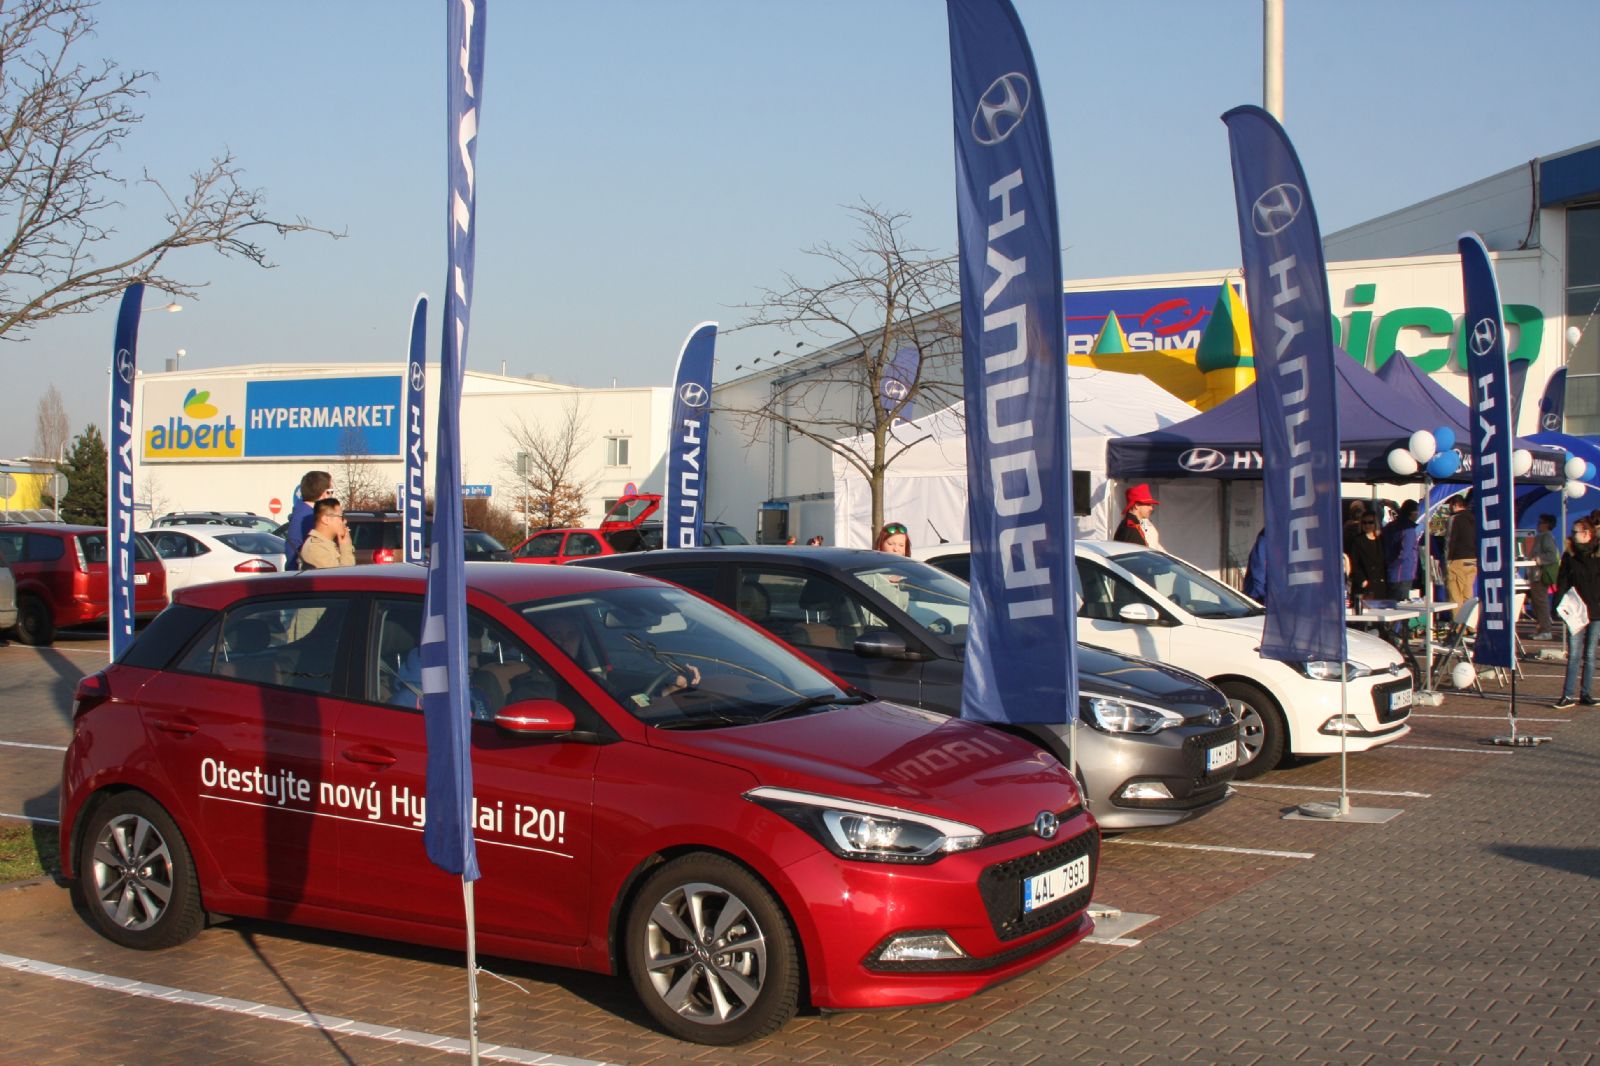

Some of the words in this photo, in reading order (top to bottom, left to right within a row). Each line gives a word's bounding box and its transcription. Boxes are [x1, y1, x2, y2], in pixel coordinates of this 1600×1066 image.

[1331, 283, 1545, 373] ico
[150, 415, 237, 450] albert
[250, 405, 396, 430] HYPERMARKET
[410, 405, 423, 560] HYUND
[680, 418, 702, 549] HYUND
[200, 756, 311, 806] Otestujte
[319, 781, 382, 821] nový
[391, 784, 503, 832] Hyai
[513, 804, 567, 845] i20!
[1035, 875, 1055, 903] 4AL
[1062, 860, 1085, 893] 7993
